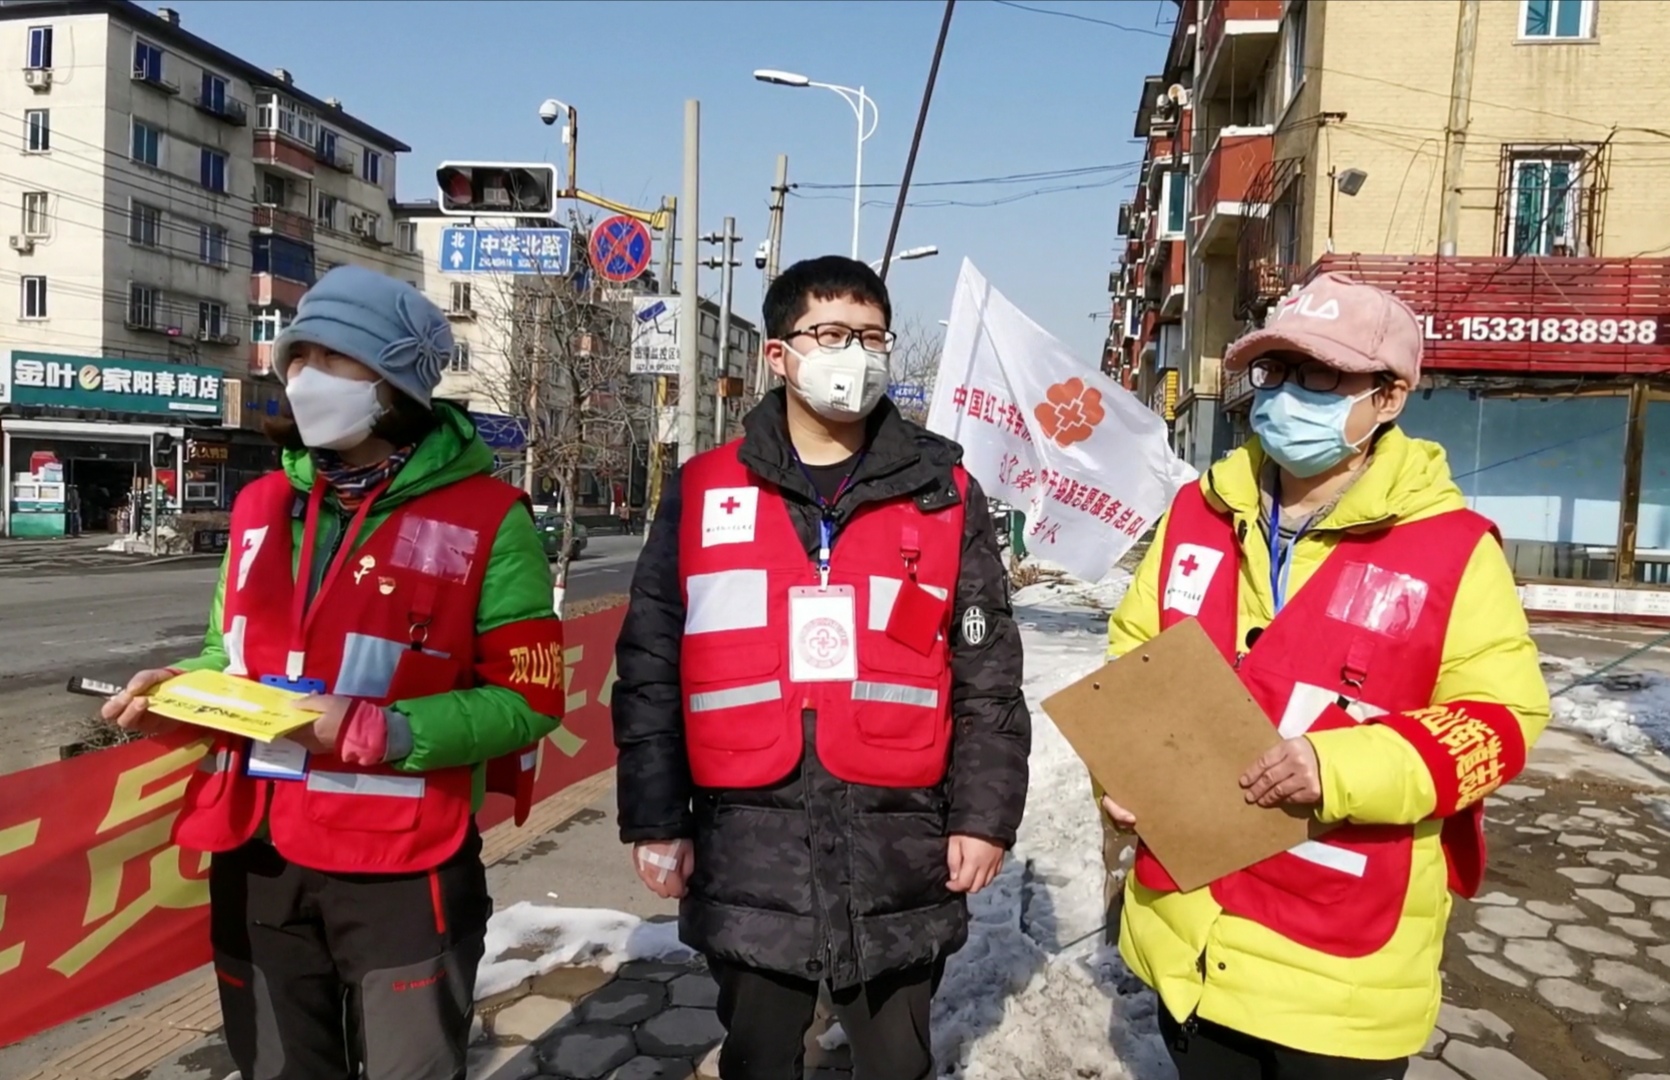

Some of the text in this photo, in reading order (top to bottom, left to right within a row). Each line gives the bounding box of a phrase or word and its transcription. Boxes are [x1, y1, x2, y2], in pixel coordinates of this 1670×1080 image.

[450, 231, 465, 249] 北
[480, 234, 563, 257] 中华北路
[1277, 293, 1340, 320] FILA
